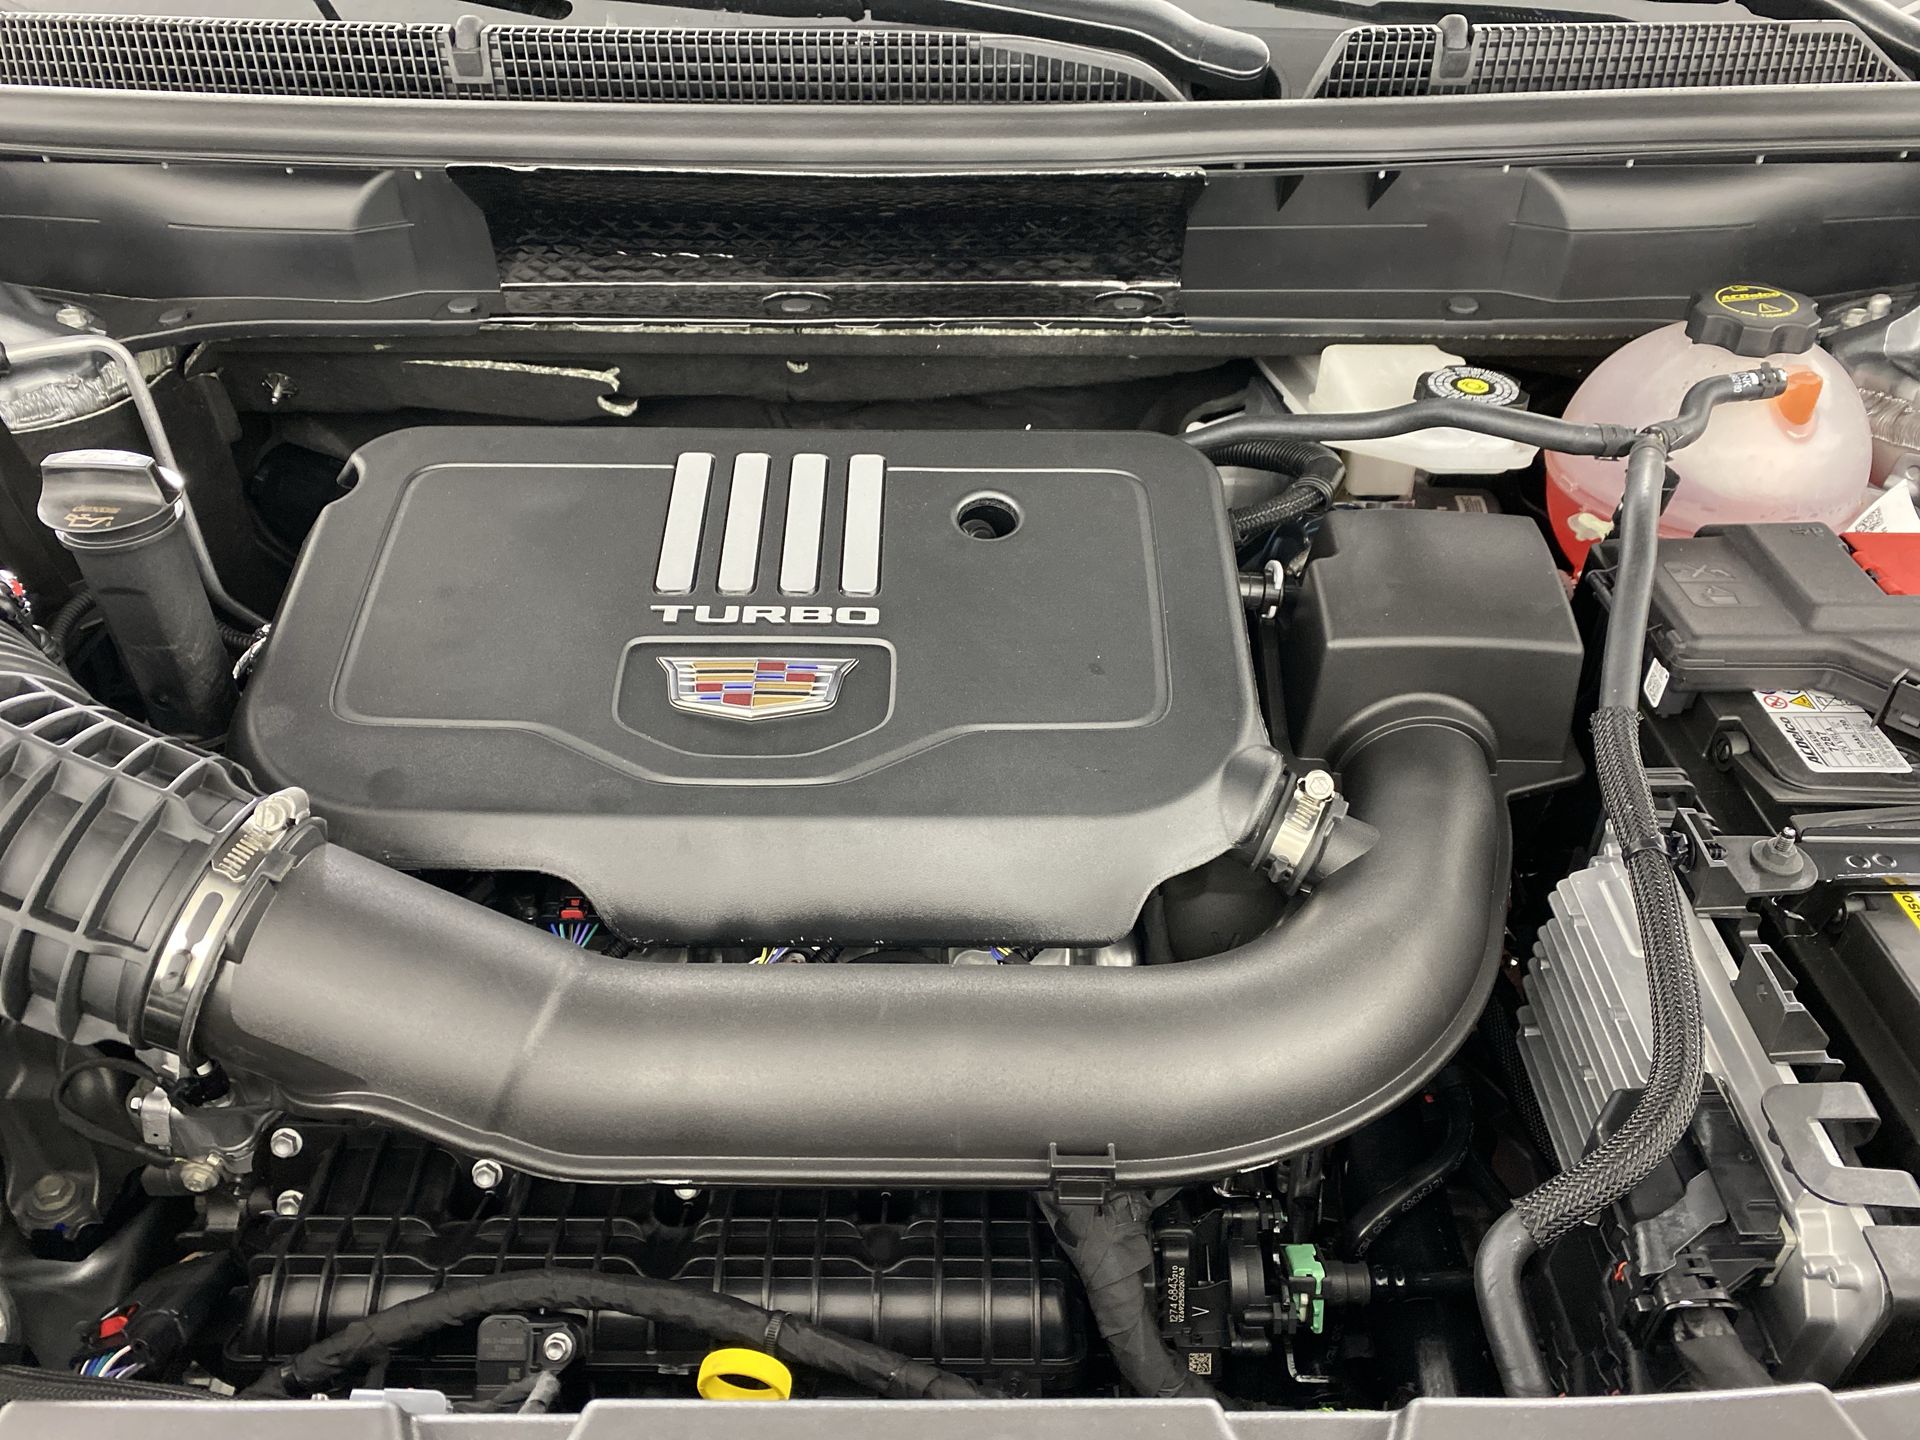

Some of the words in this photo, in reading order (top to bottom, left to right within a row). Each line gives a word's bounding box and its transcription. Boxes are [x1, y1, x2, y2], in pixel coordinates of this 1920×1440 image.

[650, 605, 880, 624] TURBO
[1780, 716, 1823, 765] ACDelco
[1816, 731, 1840, 752] 7287
[1191, 1306, 1210, 1317] V
